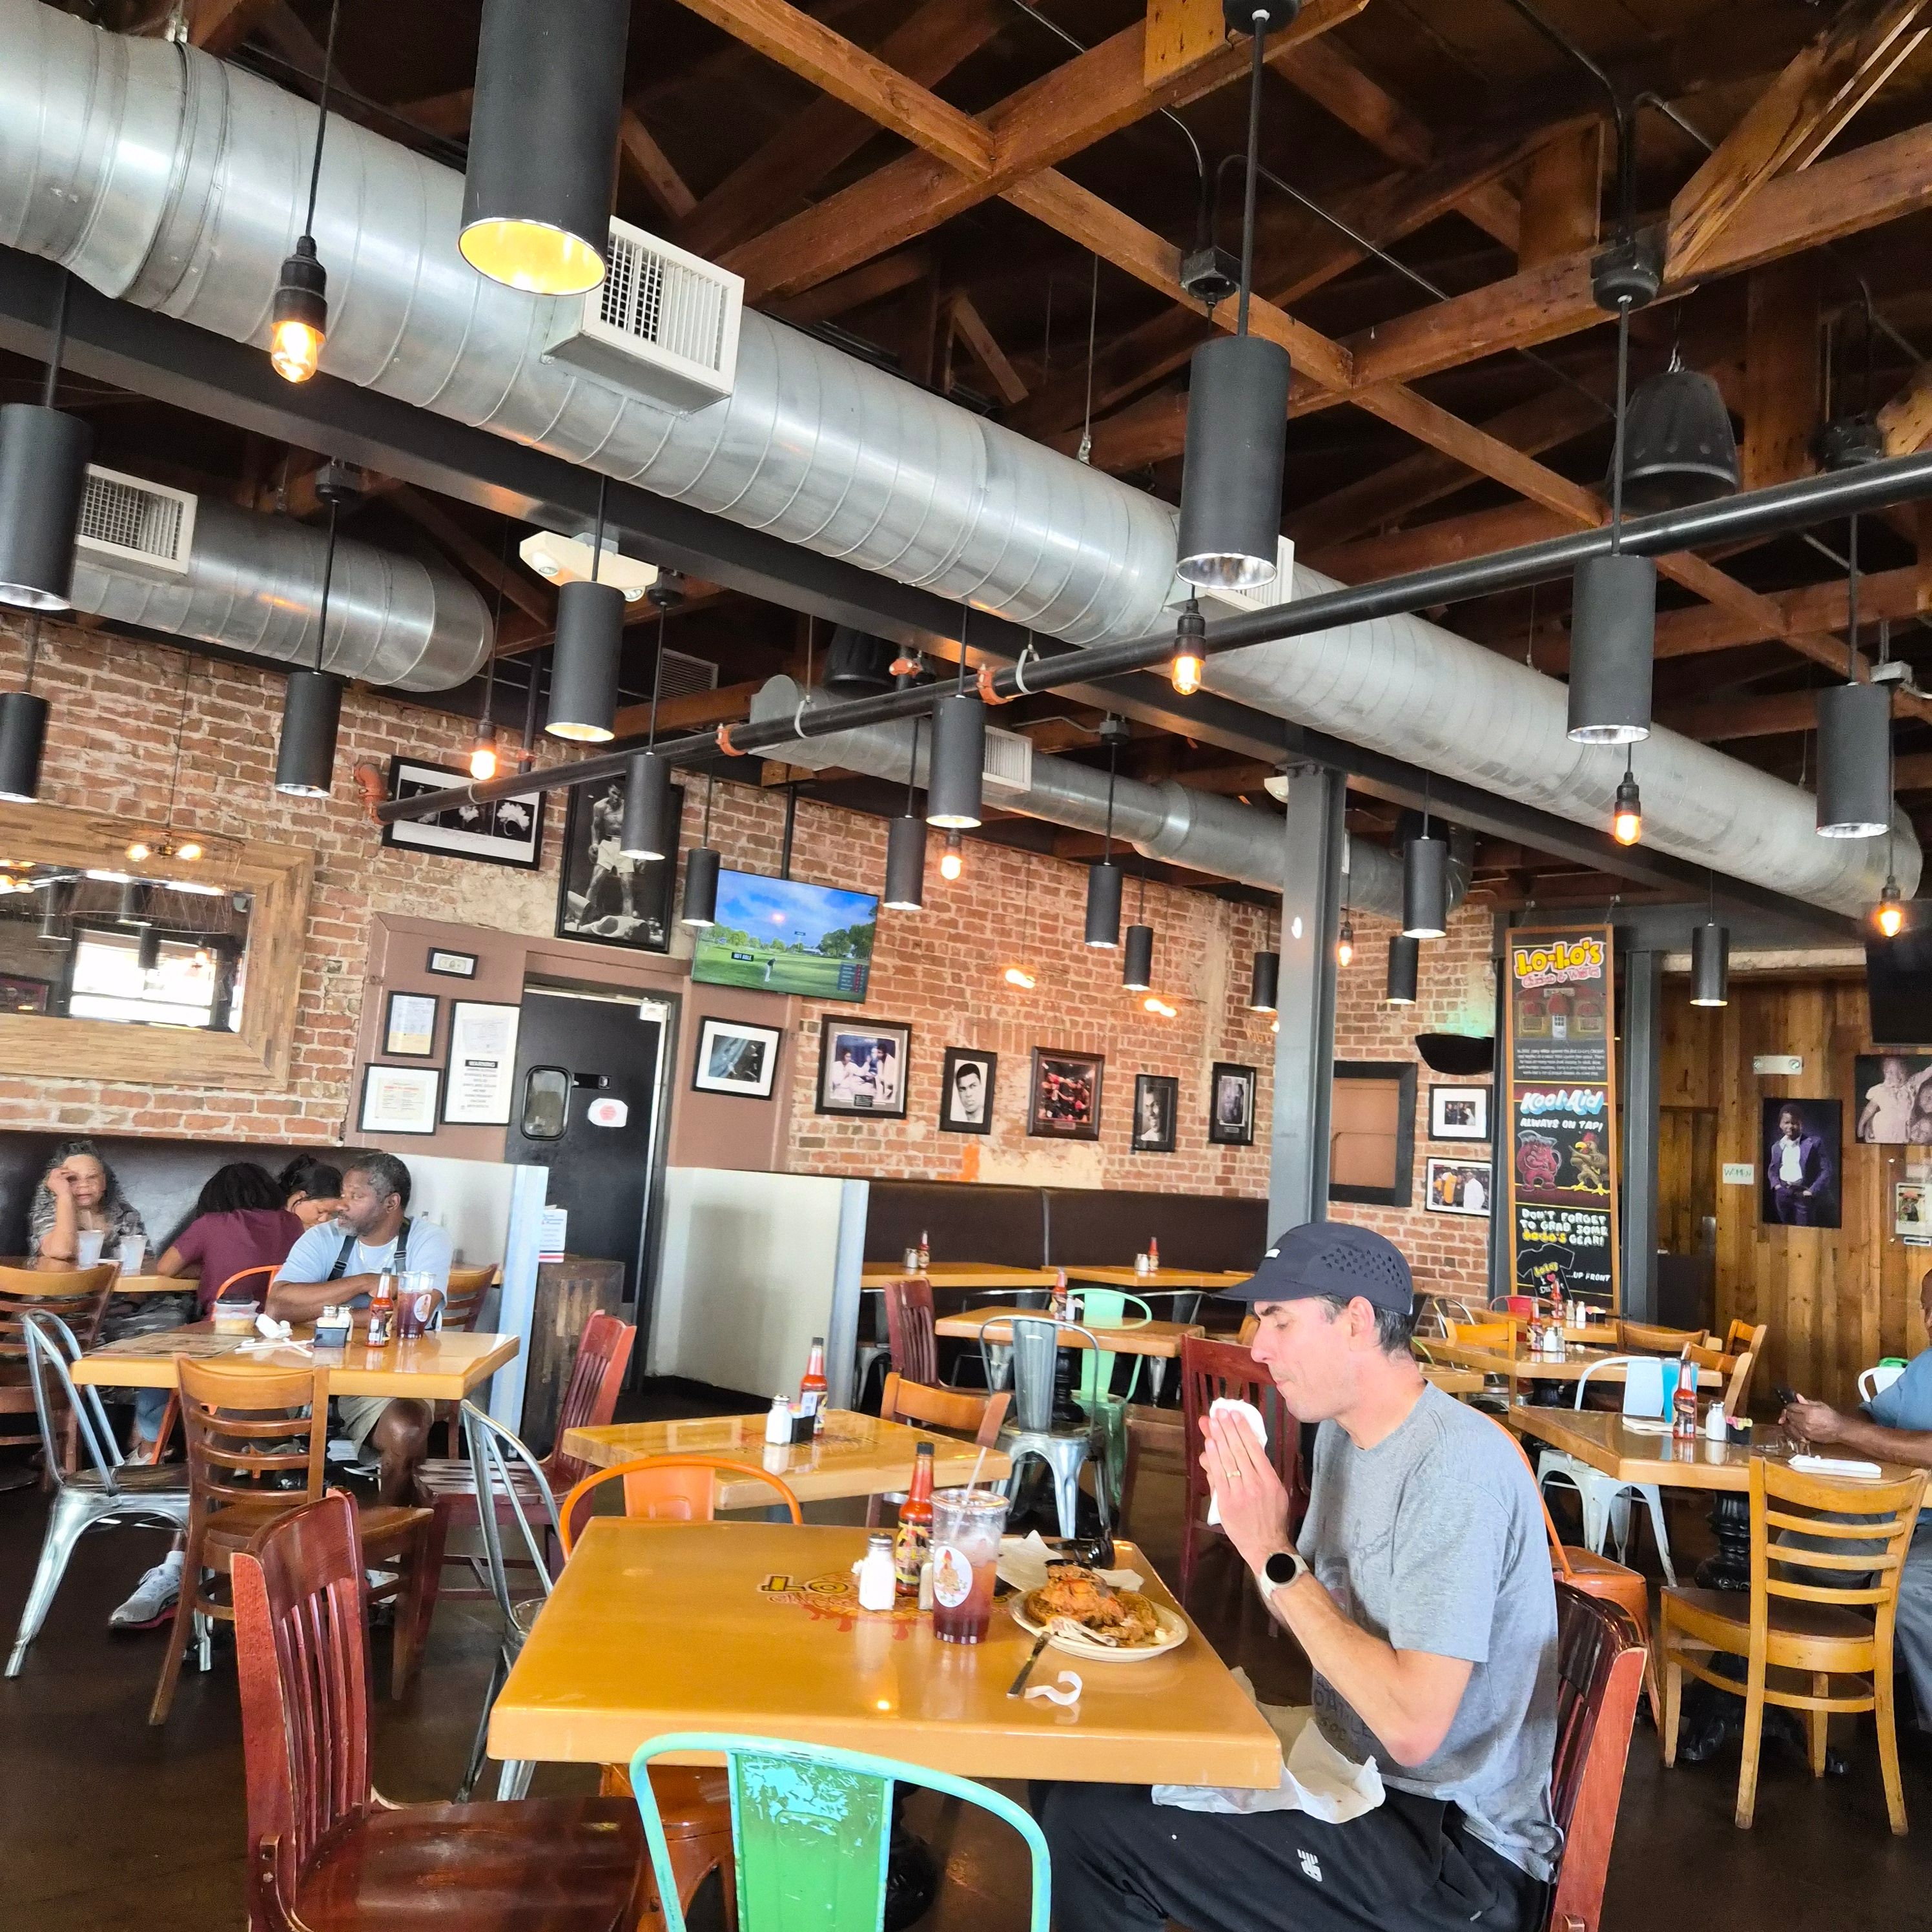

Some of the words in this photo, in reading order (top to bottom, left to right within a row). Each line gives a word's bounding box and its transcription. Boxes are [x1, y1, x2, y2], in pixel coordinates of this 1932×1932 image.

[1520, 1118, 1559, 1129] ALWAYS
[1562, 1120, 1576, 1129] ON
[1578, 1120, 1603, 1133] TAP!
[1522, 1208, 1556, 1220] DON'T
[1561, 1212, 1607, 1225] FORGET
[1519, 1219, 1537, 1230] TO
[1540, 1220, 1571, 1233] GRAB
[1576, 1224, 1608, 1236] SOME
[1568, 1234, 1605, 1247] GEAR!
[1585, 1273, 1611, 1282] FRONT
